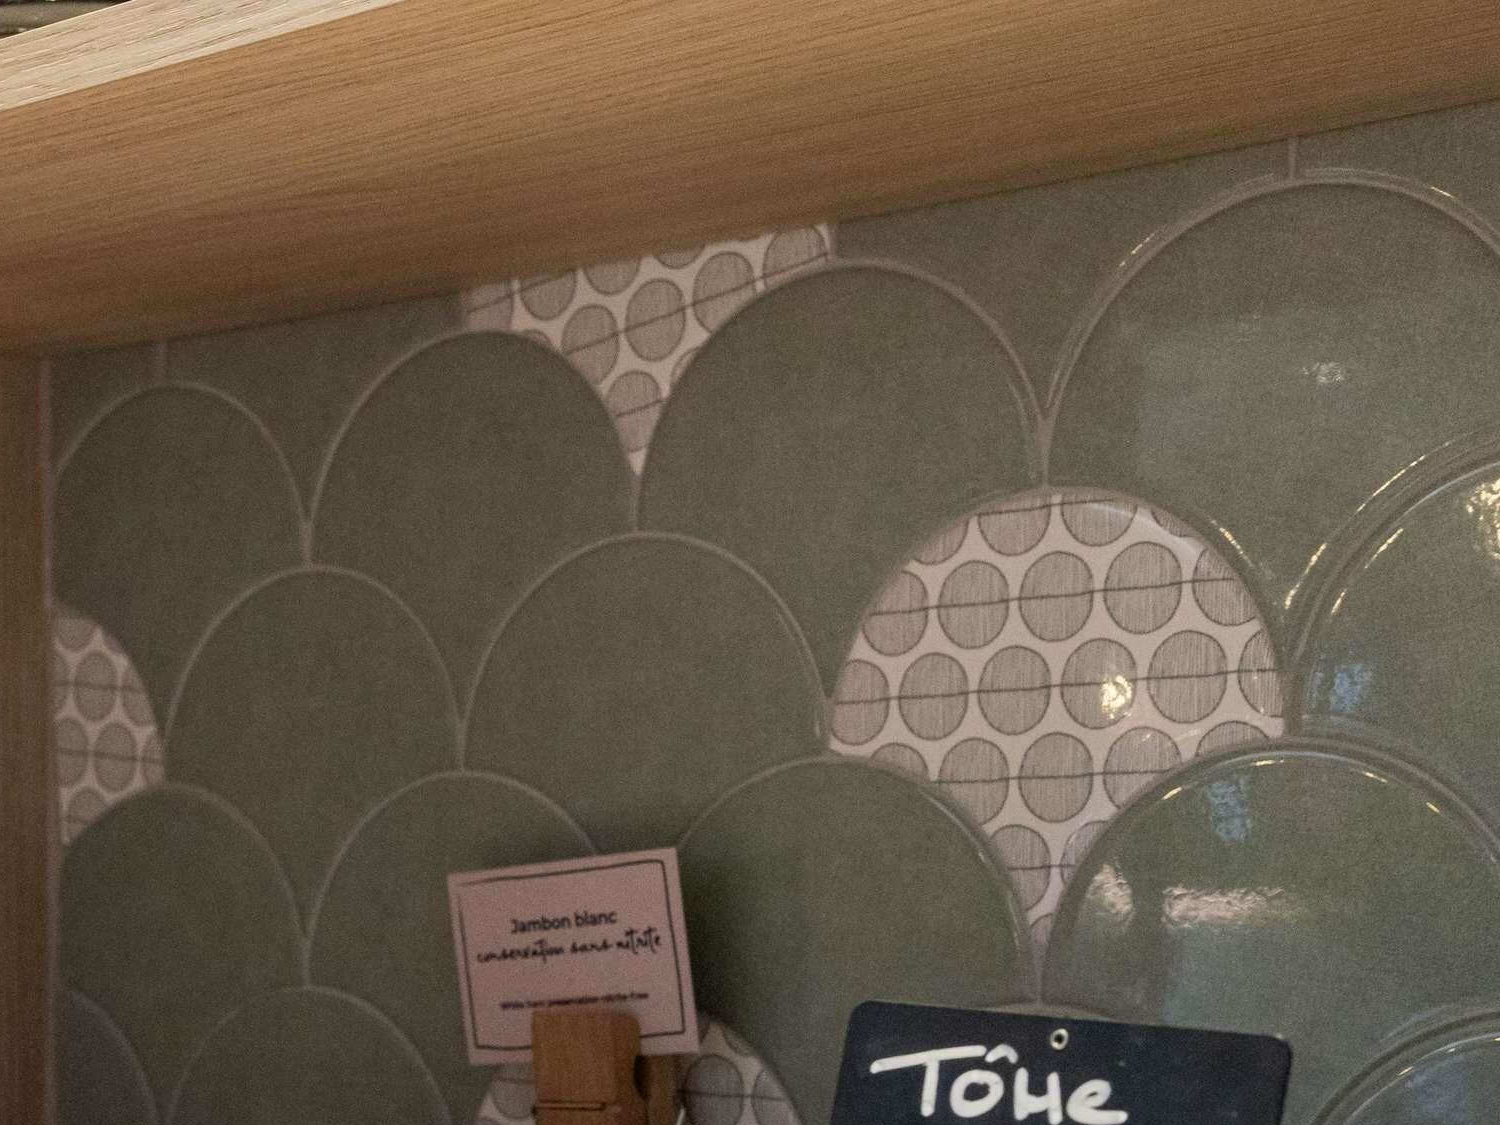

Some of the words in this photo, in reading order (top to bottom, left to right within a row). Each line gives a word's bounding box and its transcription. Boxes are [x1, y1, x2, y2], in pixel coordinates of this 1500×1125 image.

[511, 915, 571, 934] Jambon
[574, 910, 617, 928] blanc
[570, 939, 612, 953] sans
[616, 926, 661, 955] nitrite
